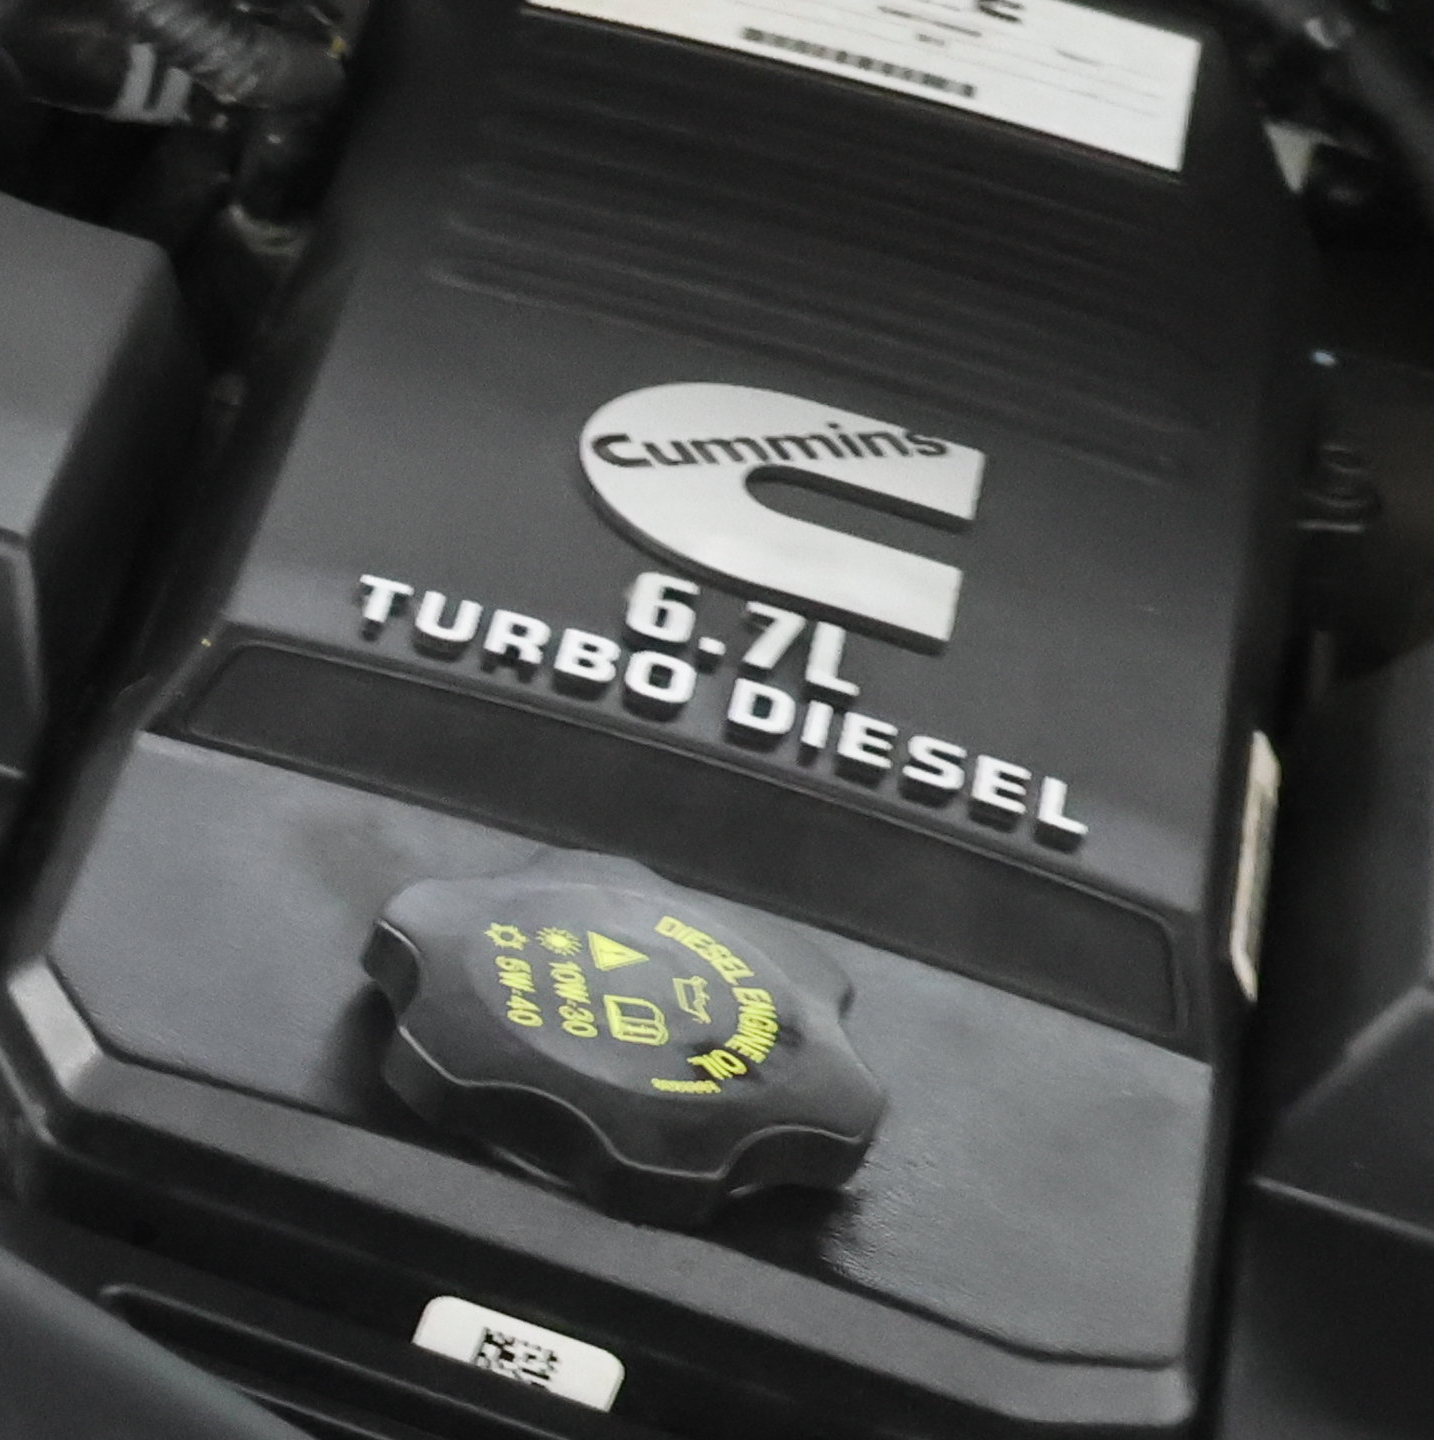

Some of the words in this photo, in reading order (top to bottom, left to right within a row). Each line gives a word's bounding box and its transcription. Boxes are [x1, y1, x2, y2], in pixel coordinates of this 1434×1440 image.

[591, 422, 949, 468] Cummins
[626, 571, 860, 698] 6.7L
[359, 573, 697, 706] TURBO
[726, 678, 1088, 837] DIESEL
[654, 916, 755, 986] DIESEL
[549, 961, 598, 1038] 10W-30
[724, 987, 780, 1064] ENGINE
[687, 1049, 748, 1081] OIL
